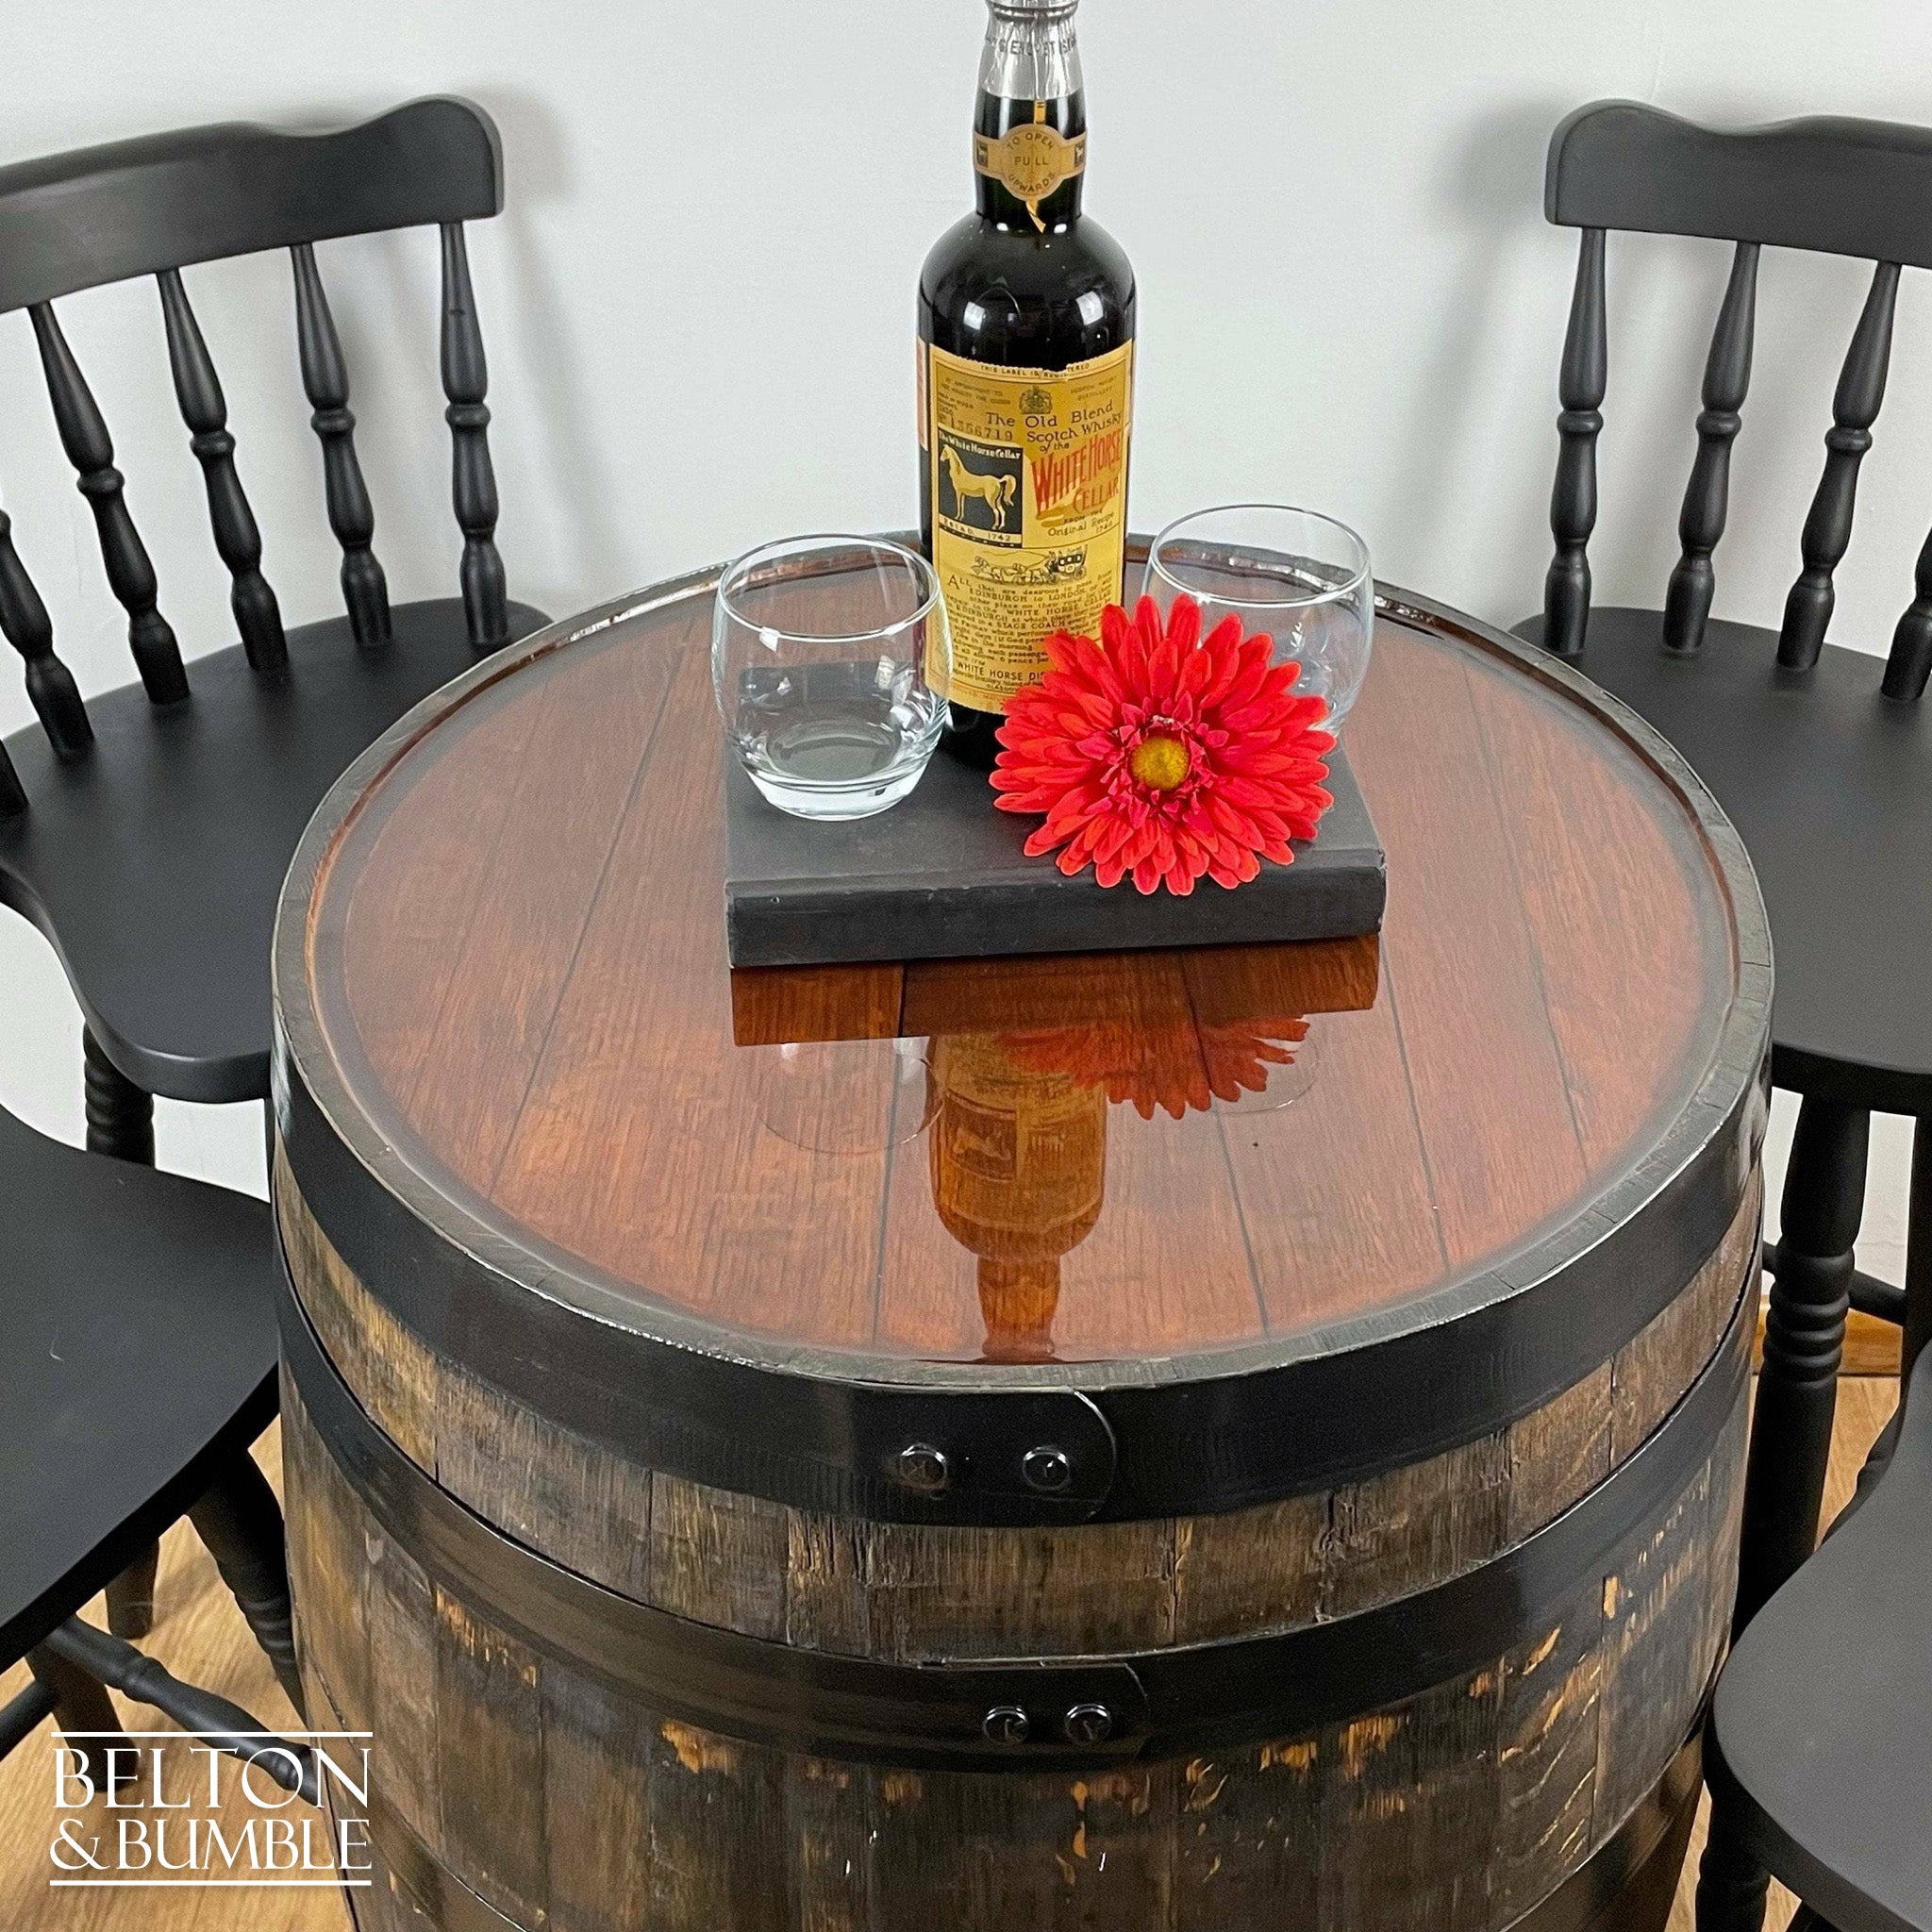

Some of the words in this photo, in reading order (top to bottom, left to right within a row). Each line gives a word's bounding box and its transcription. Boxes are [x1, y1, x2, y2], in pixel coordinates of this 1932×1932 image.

[1007, 136, 1021, 151] TO
[1025, 132, 1055, 151] OPEN
[1014, 156, 1049, 166] PULL
[1008, 172, 1056, 192] UPWARDS
[981, 365, 998, 374] THIS
[1001, 368, 1026, 376] LABEL
[986, 411, 1016, 427] The
[1024, 415, 1058, 428] Old
[1071, 399, 1113, 424] Blend
[1026, 427, 1078, 442] Scotch
[948, 435, 971, 451] White
[971, 442, 995, 458] Horse
[1054, 441, 1070, 450] the
[987, 533, 1011, 542] 1742
[969, 588, 1027, 602] EDINBURGH
[1031, 620, 1065, 629] COACH
[958, 661, 985, 676] WHITE
[990, 669, 1024, 681] HORSE
